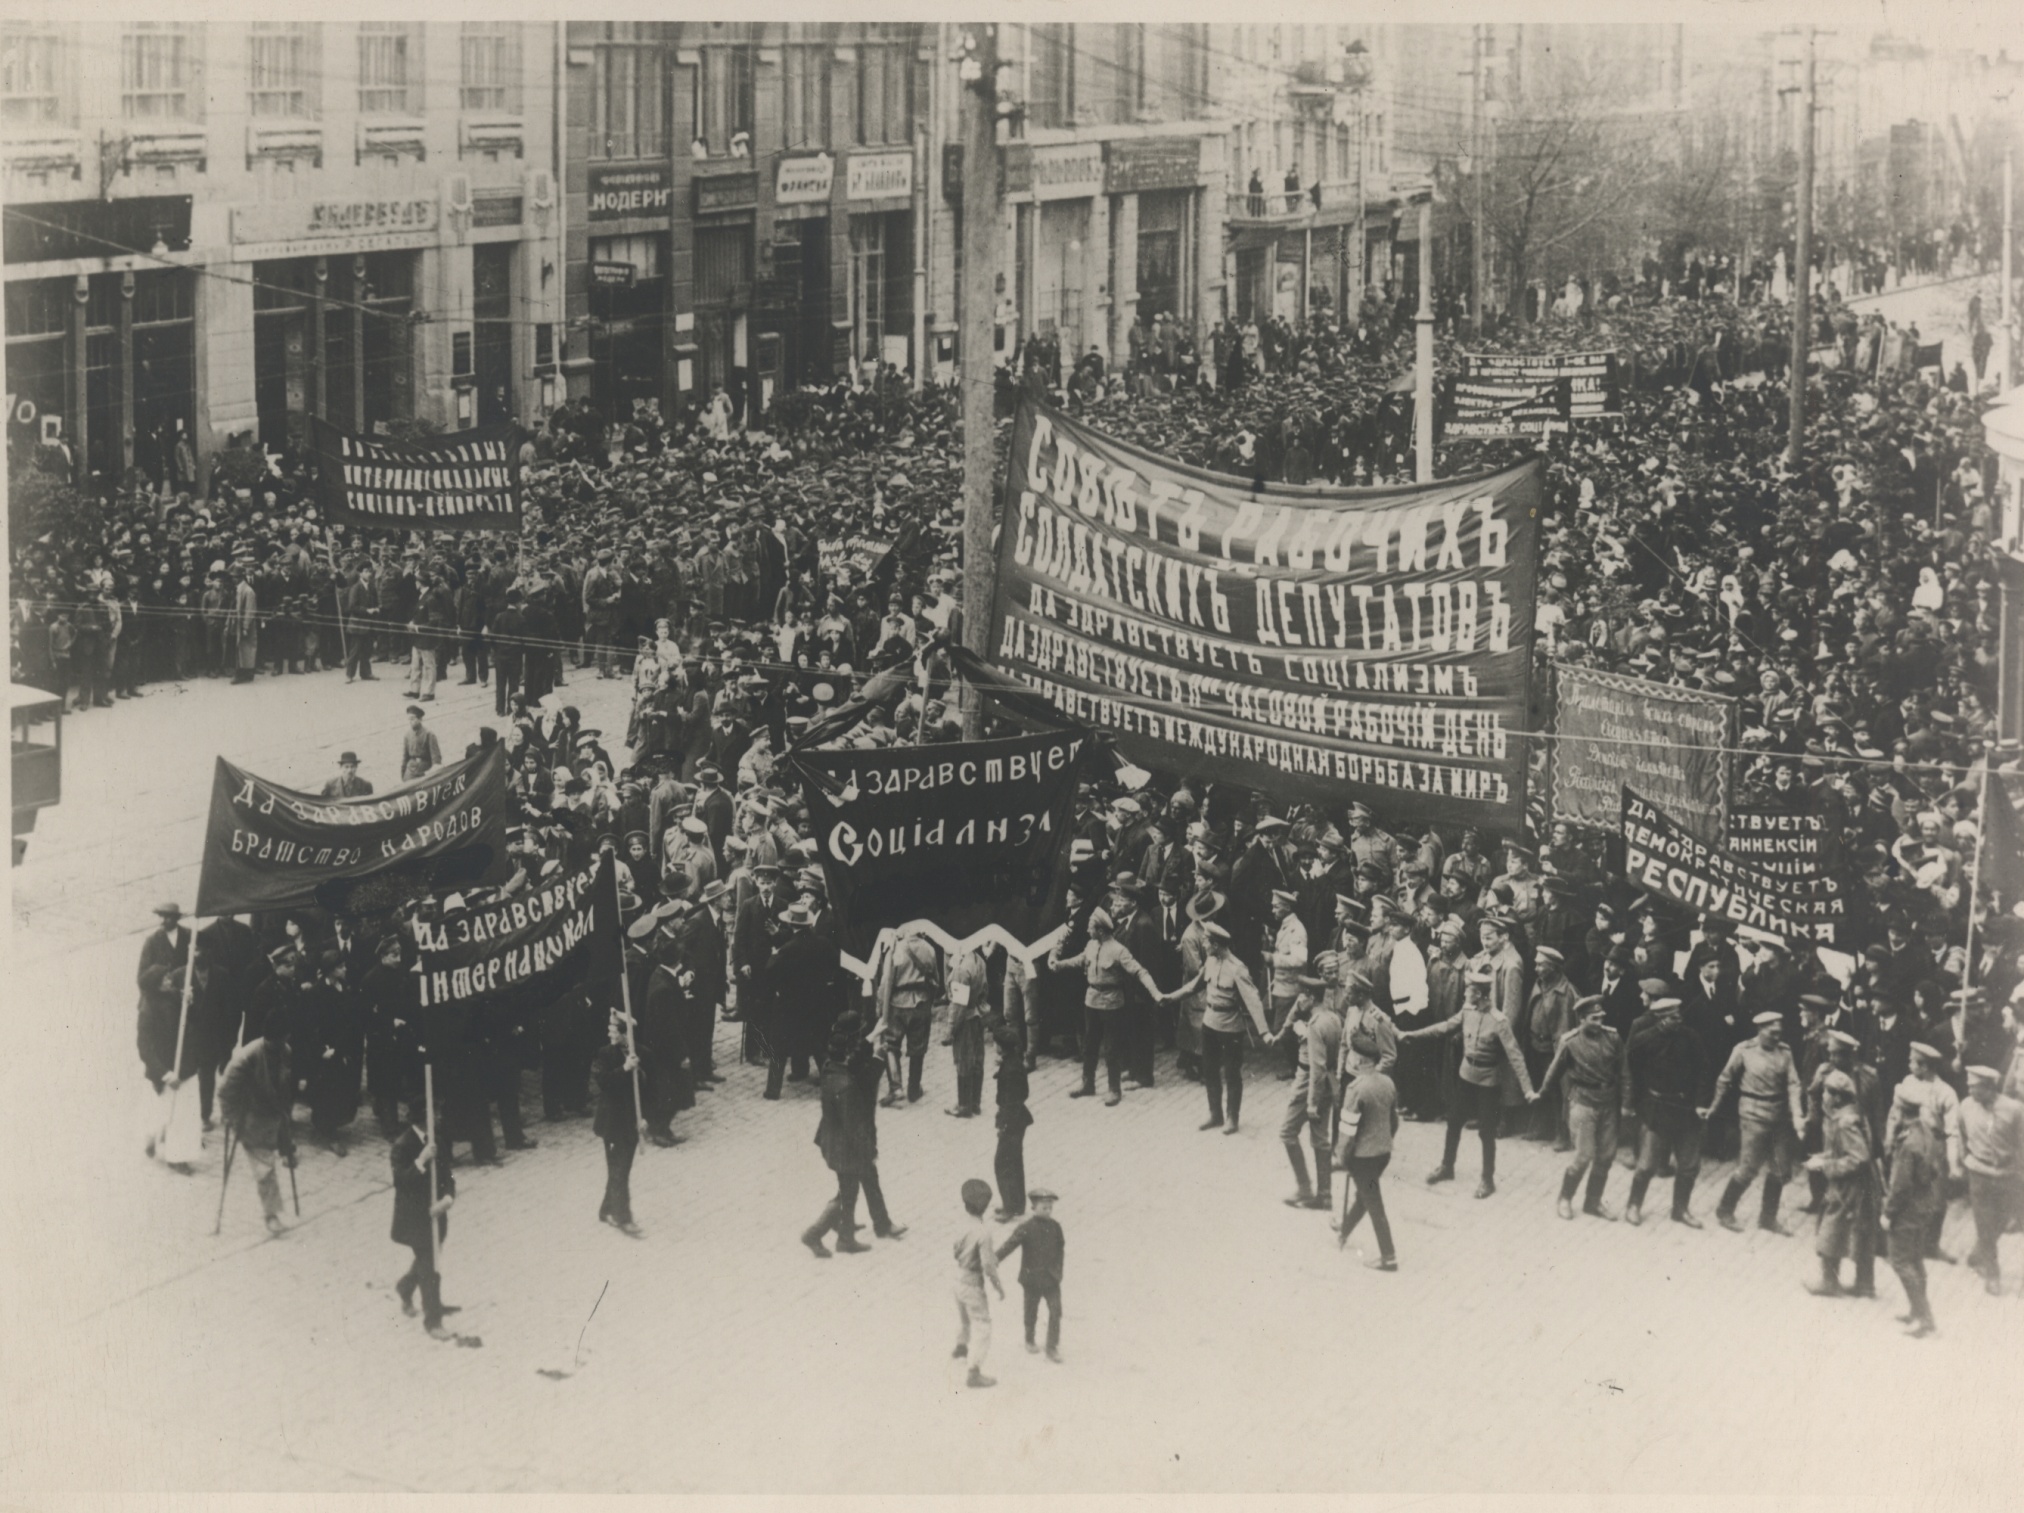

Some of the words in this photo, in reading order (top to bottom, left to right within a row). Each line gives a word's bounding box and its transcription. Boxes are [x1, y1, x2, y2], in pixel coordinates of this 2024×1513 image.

[1014, 491, 1231, 634] СОЛДАТСКИХЪ
[1256, 576, 1512, 654] ДЕПУТАТОВЪ
[1222, 497, 1510, 574] РАБОЧИХЪ
[1029, 583, 1057, 619] ДА
[1066, 598, 1263, 675] ЗДРАВСТВУЕТЪ
[1284, 655, 1478, 697] СОЦІАЛИЗМЪ
[1000, 615, 1025, 660] ДА
[1027, 623, 1182, 704] ЗДРАВСТВУЕТЪ
[1224, 680, 1328, 736] ЧАСОВОЙ
[1442, 709, 1507, 761] ДЕНЬ
[1335, 754, 1415, 791] БОРЬБА
[1418, 763, 1444, 796] ЗА
[1450, 768, 1510, 804] МИРЪ
[1628, 798, 1658, 825] ДА
[1729, 834, 1818, 853] АННЕКСІИ
[1626, 848, 1836, 944] РЕСПУБЛИКА
